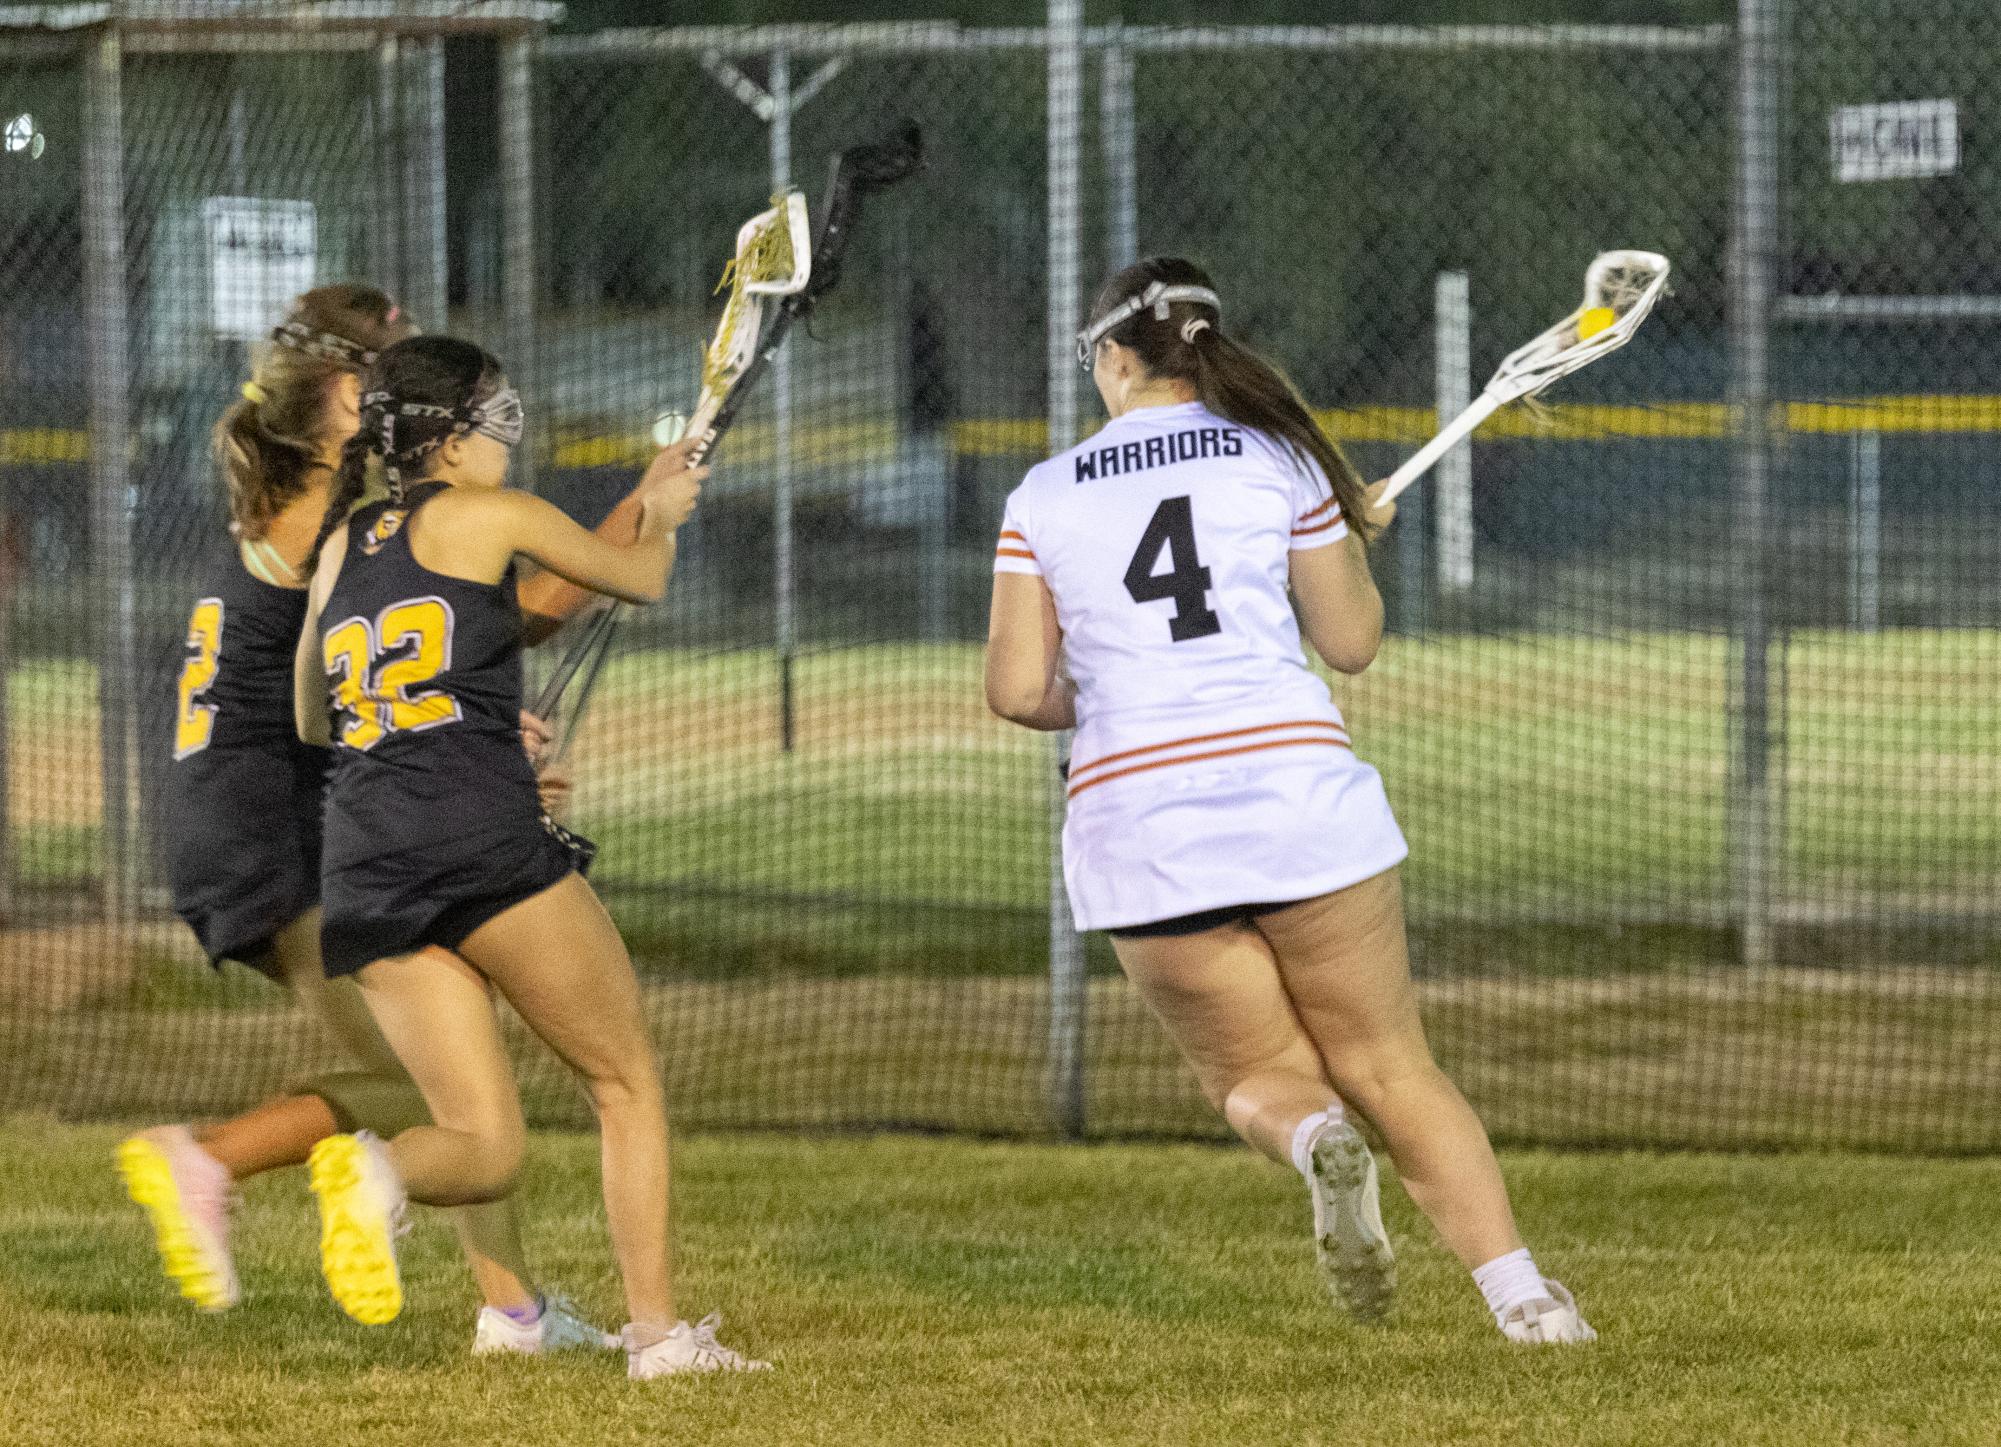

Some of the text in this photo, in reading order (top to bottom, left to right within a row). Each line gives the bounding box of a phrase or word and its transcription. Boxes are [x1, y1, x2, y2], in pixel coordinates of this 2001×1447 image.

[1075, 428, 1243, 484] WARRIORS
[1123, 495, 1222, 643] 4
[173, 597, 224, 761] 2
[323, 595, 463, 751] 32
